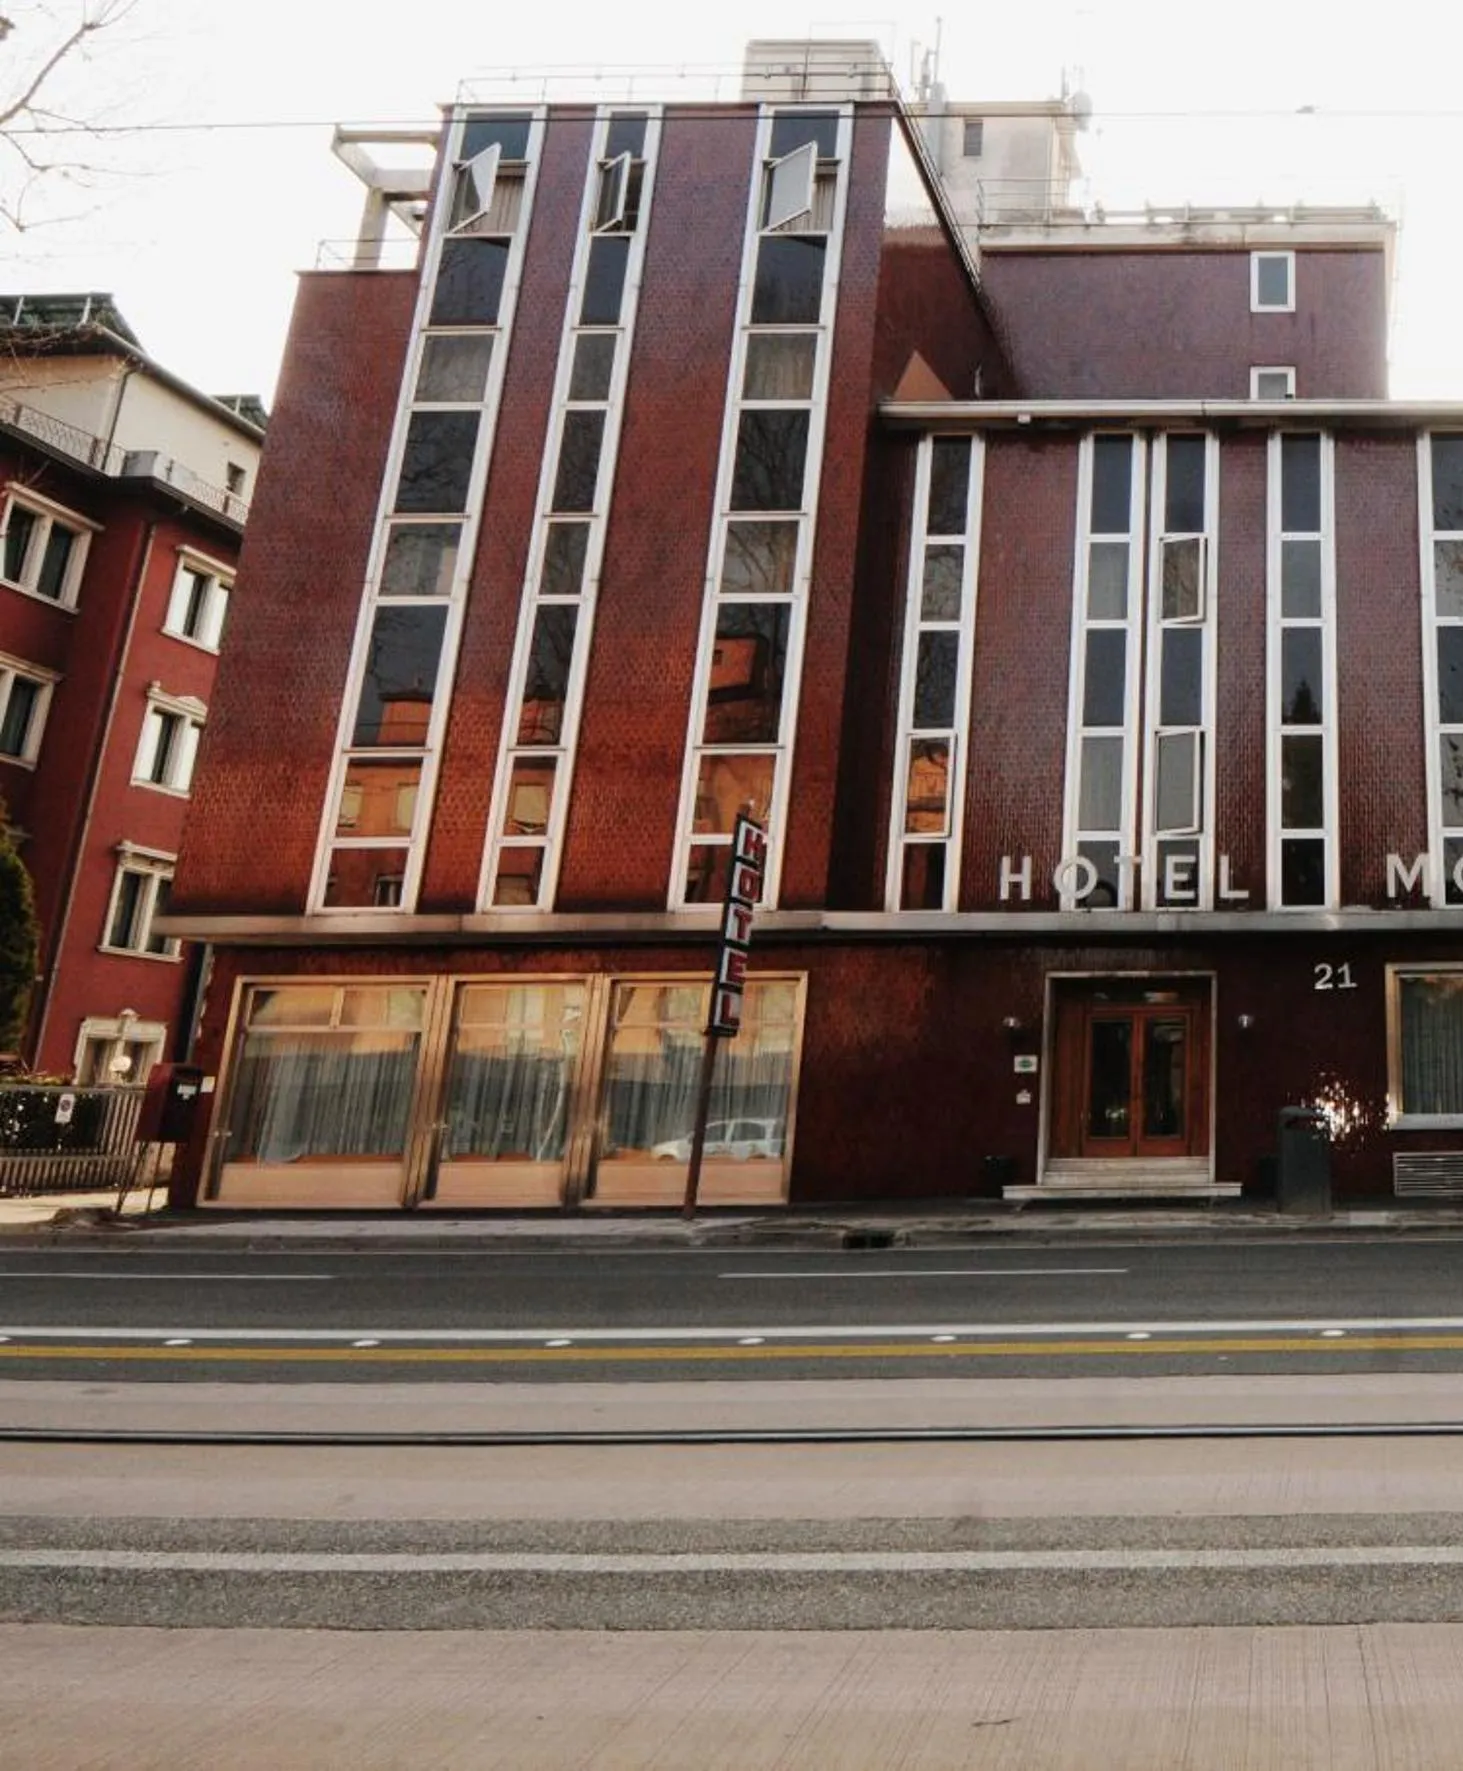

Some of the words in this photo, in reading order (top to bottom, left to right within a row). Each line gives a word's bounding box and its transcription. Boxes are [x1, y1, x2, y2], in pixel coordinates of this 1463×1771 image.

[999, 854, 1250, 901] HOTEL
[720, 826, 766, 1027] HOTEL
[1314, 961, 1358, 990] 21
